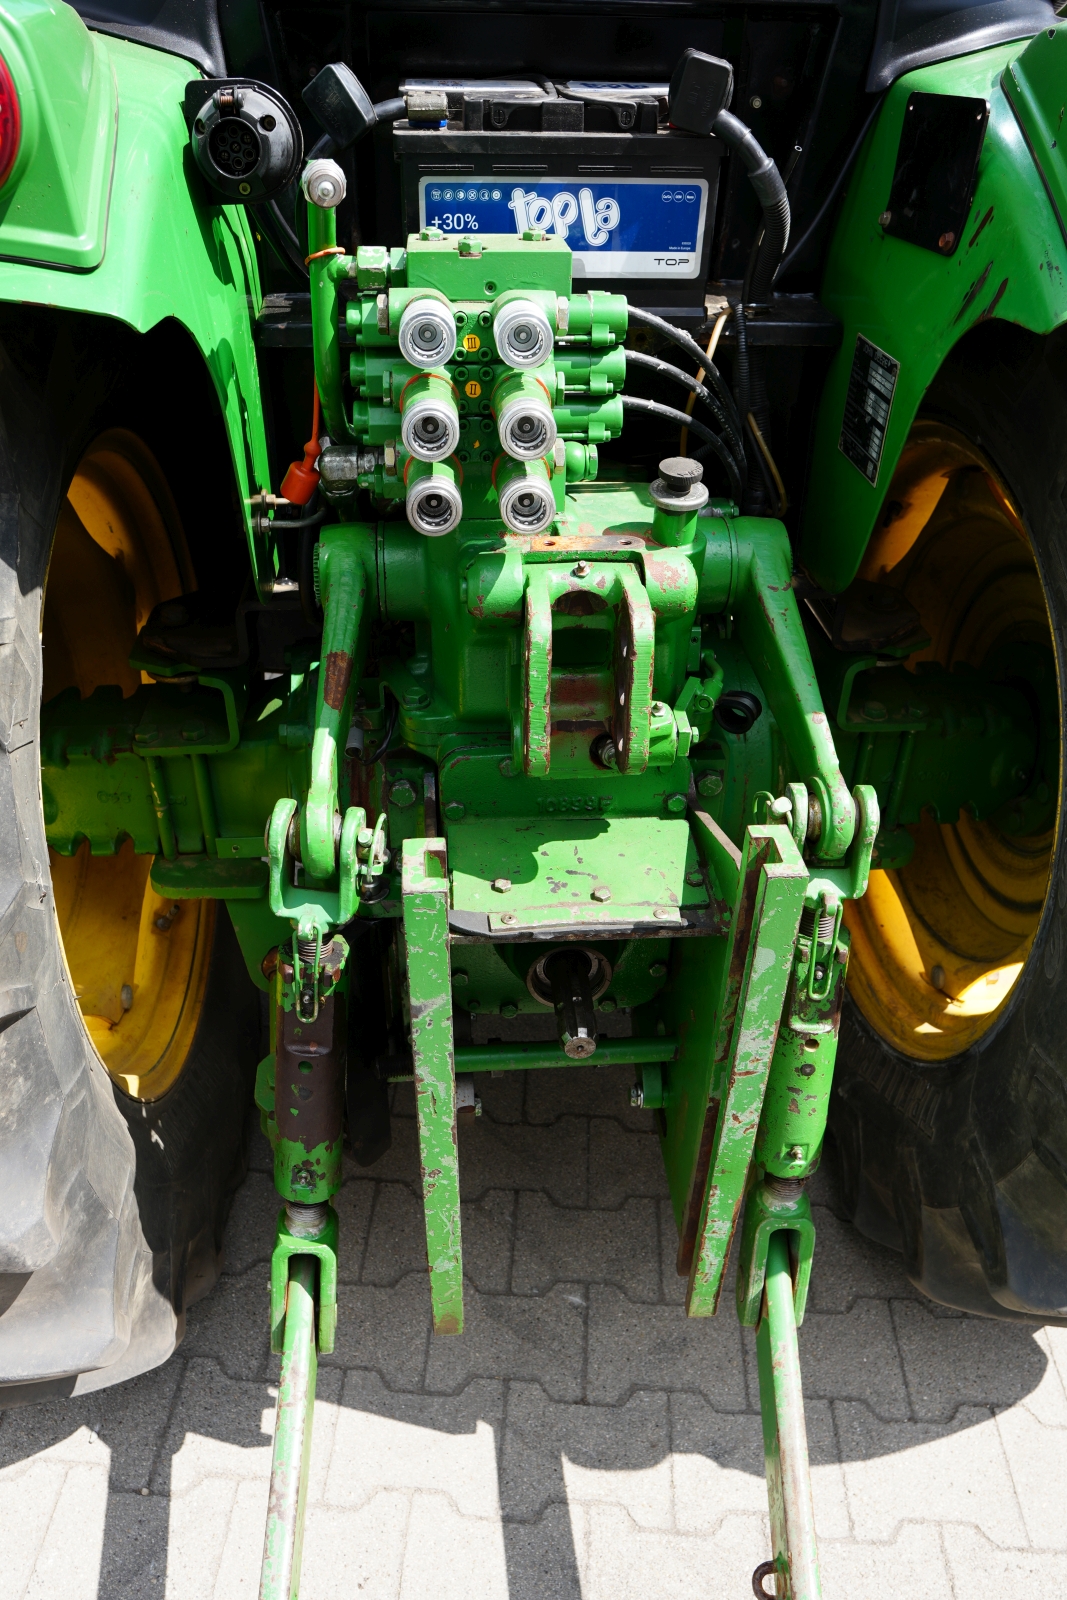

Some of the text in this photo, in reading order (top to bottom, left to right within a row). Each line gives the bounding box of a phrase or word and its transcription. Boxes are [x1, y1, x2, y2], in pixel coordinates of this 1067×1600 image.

[431, 213, 479, 230] +30%
[508, 187, 620, 246] topla
[655, 258, 690, 266] TOP
[467, 337, 477, 349] III
[470, 384, 477, 395] II
